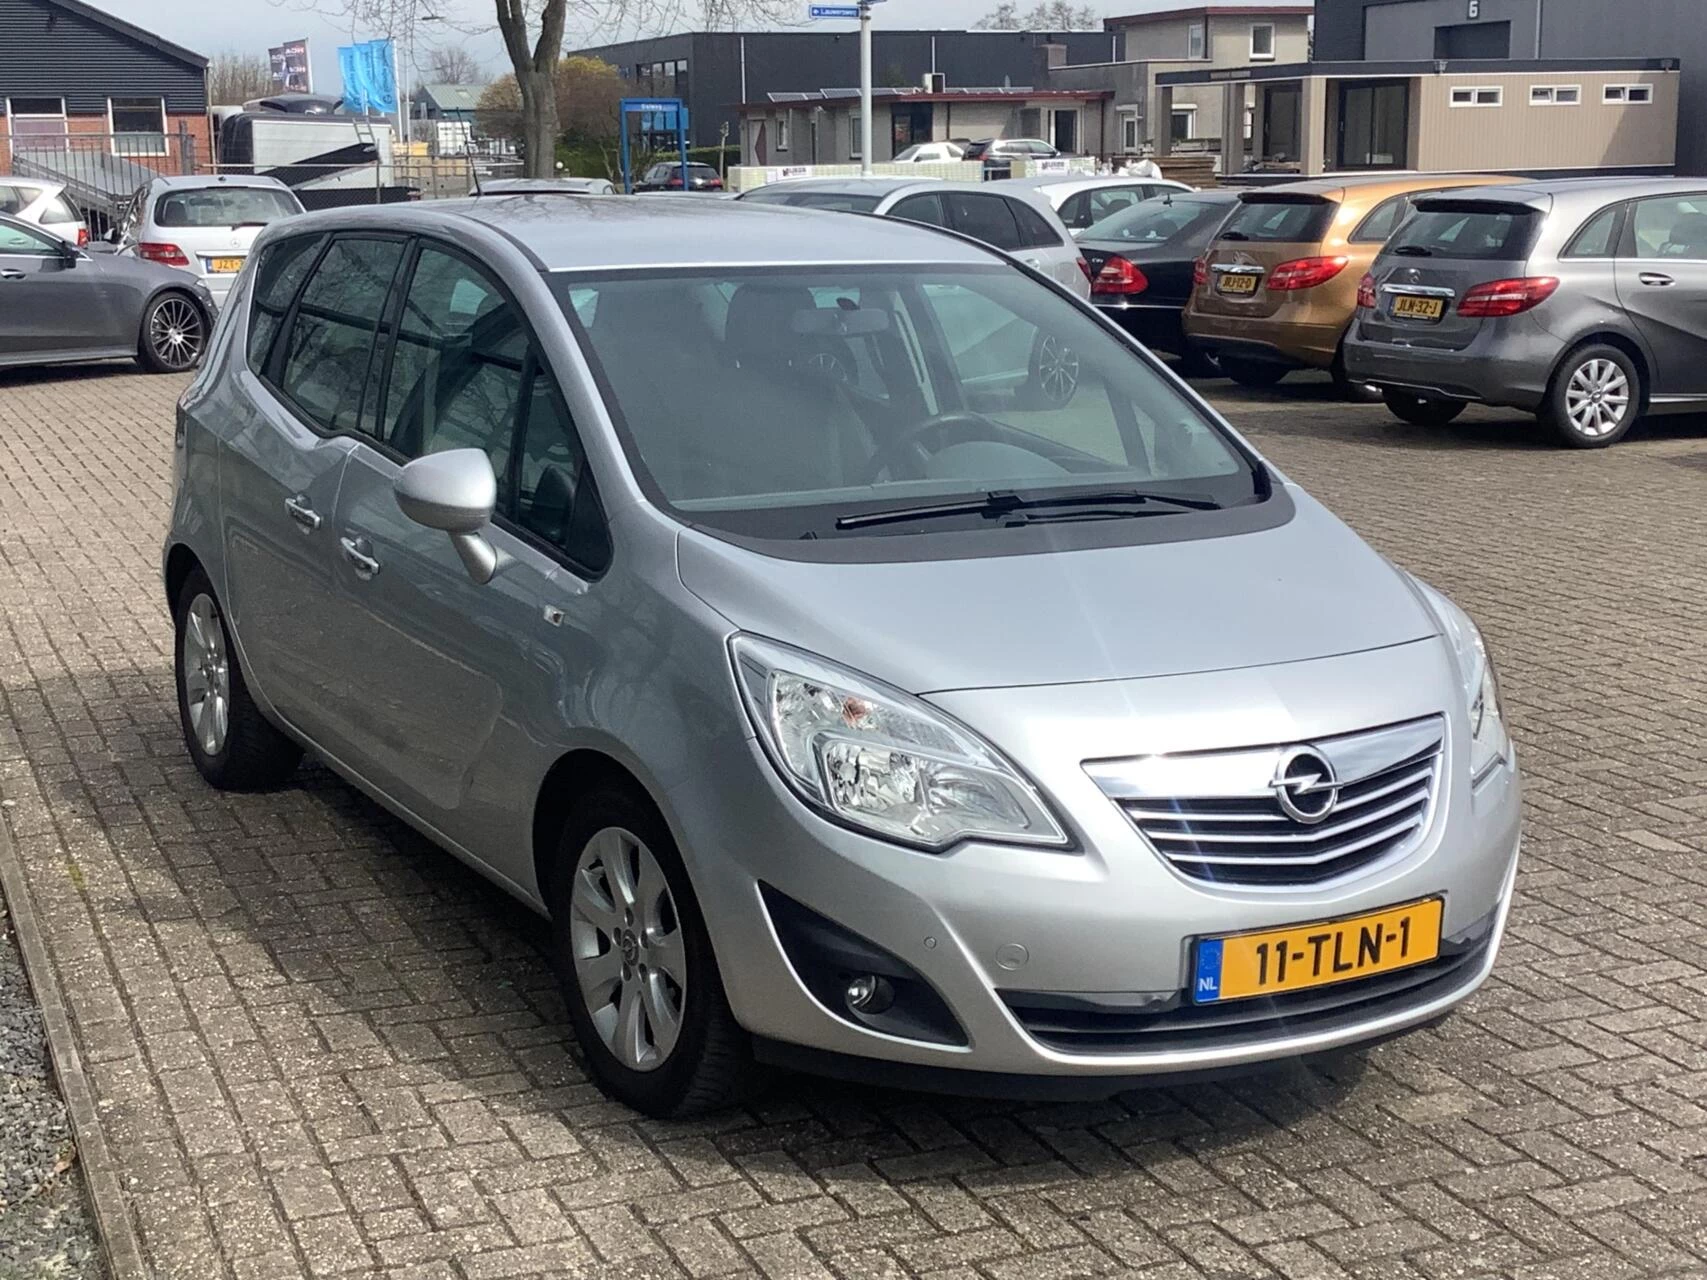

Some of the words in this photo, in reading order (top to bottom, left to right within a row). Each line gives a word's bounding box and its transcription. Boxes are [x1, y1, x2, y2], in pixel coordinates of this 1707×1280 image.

[1469, 0, 1478, 18] 6
[1397, 299, 1438, 315] JLN-32-J
[1257, 916, 1411, 985] 11-TLN-1
[1199, 977, 1217, 991] NL
